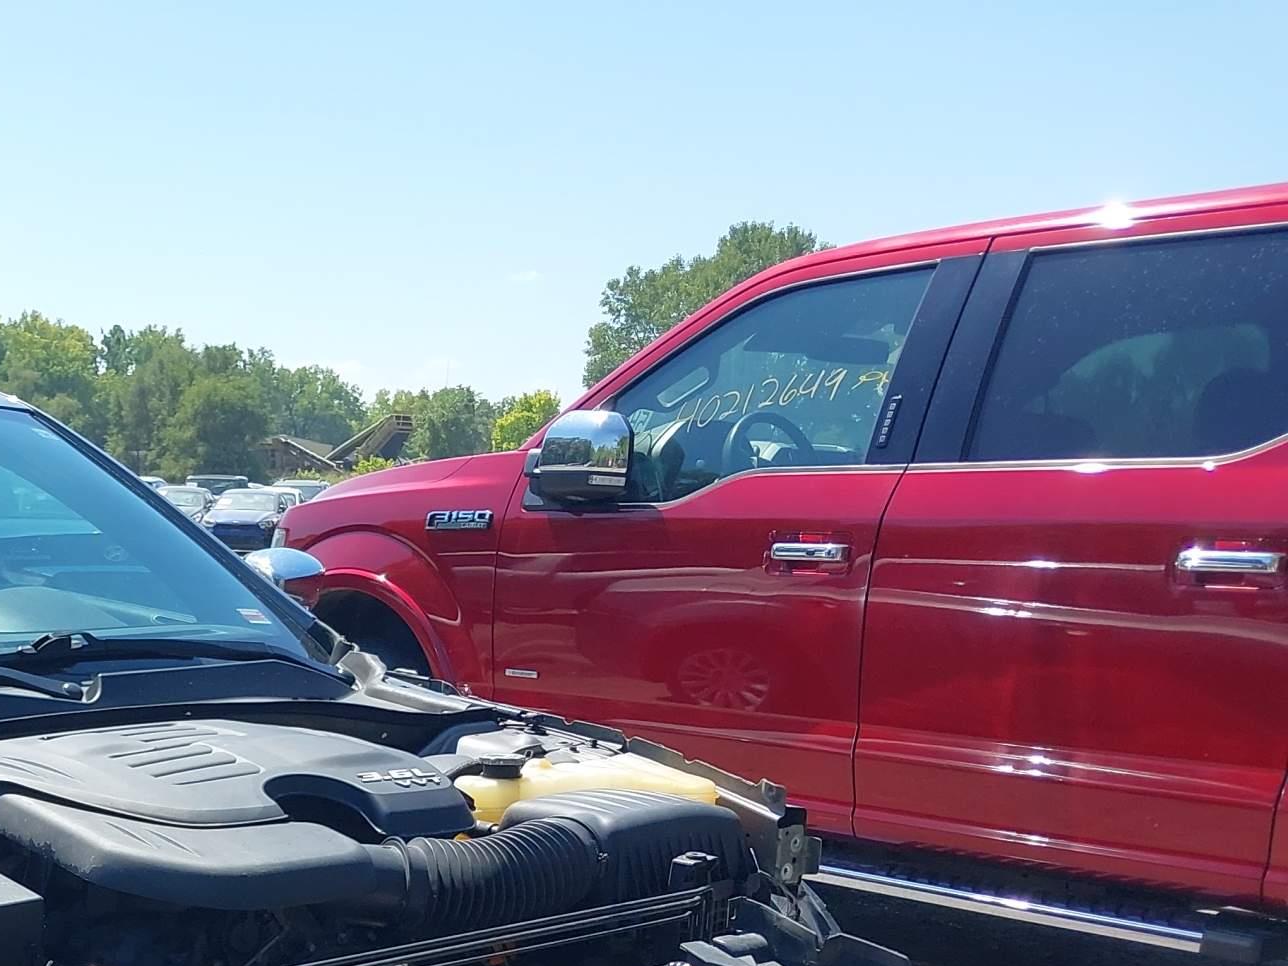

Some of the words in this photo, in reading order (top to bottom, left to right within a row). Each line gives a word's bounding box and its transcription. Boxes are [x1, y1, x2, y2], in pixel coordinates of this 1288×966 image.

[674, 367, 848, 433] 40212649
[357, 768, 436, 783] 3.6L
[393, 776, 441, 787] VVT
